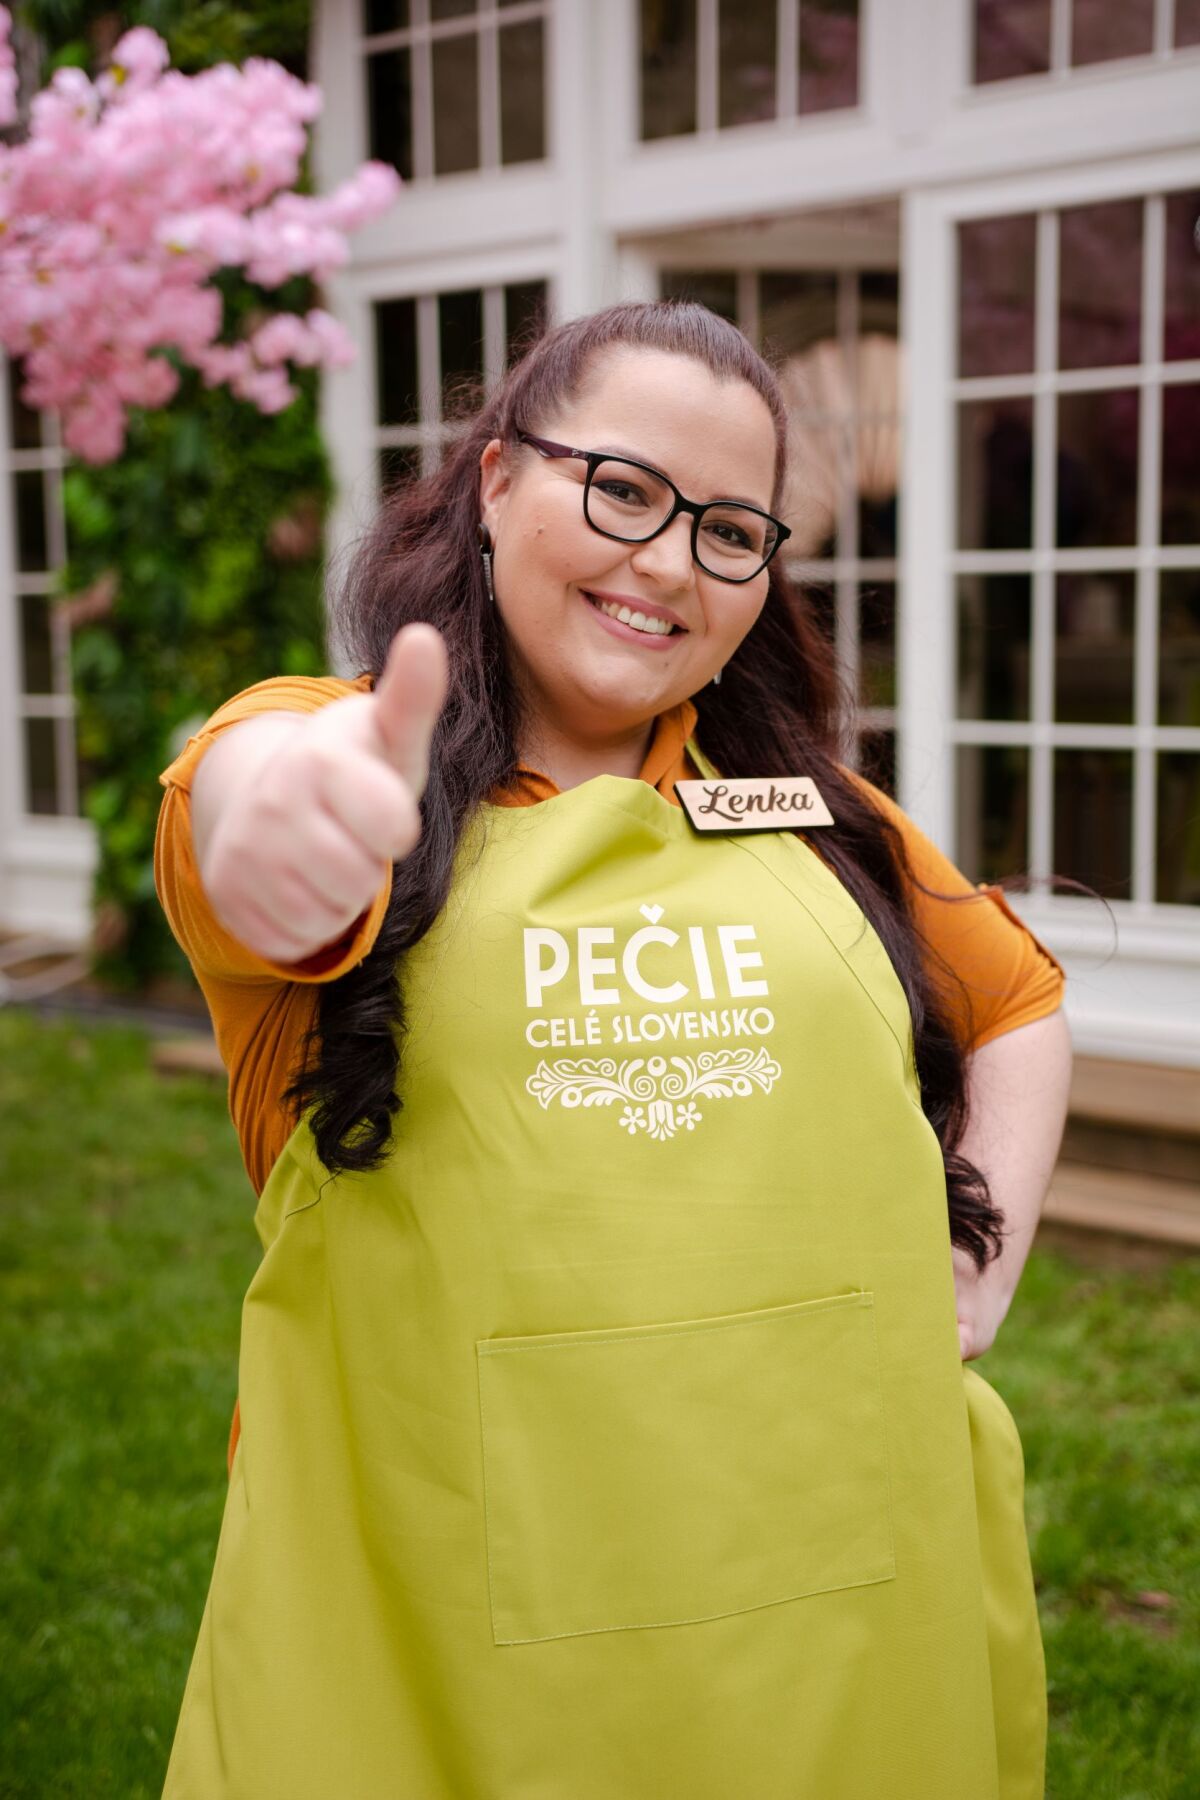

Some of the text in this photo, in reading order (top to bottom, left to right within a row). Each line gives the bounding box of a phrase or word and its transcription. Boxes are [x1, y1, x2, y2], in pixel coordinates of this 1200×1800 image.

[698, 784, 814, 822] Lenka
[523, 903, 769, 1007] PEČIE
[525, 1006, 775, 1048] CELÉ SLOVENSKO
